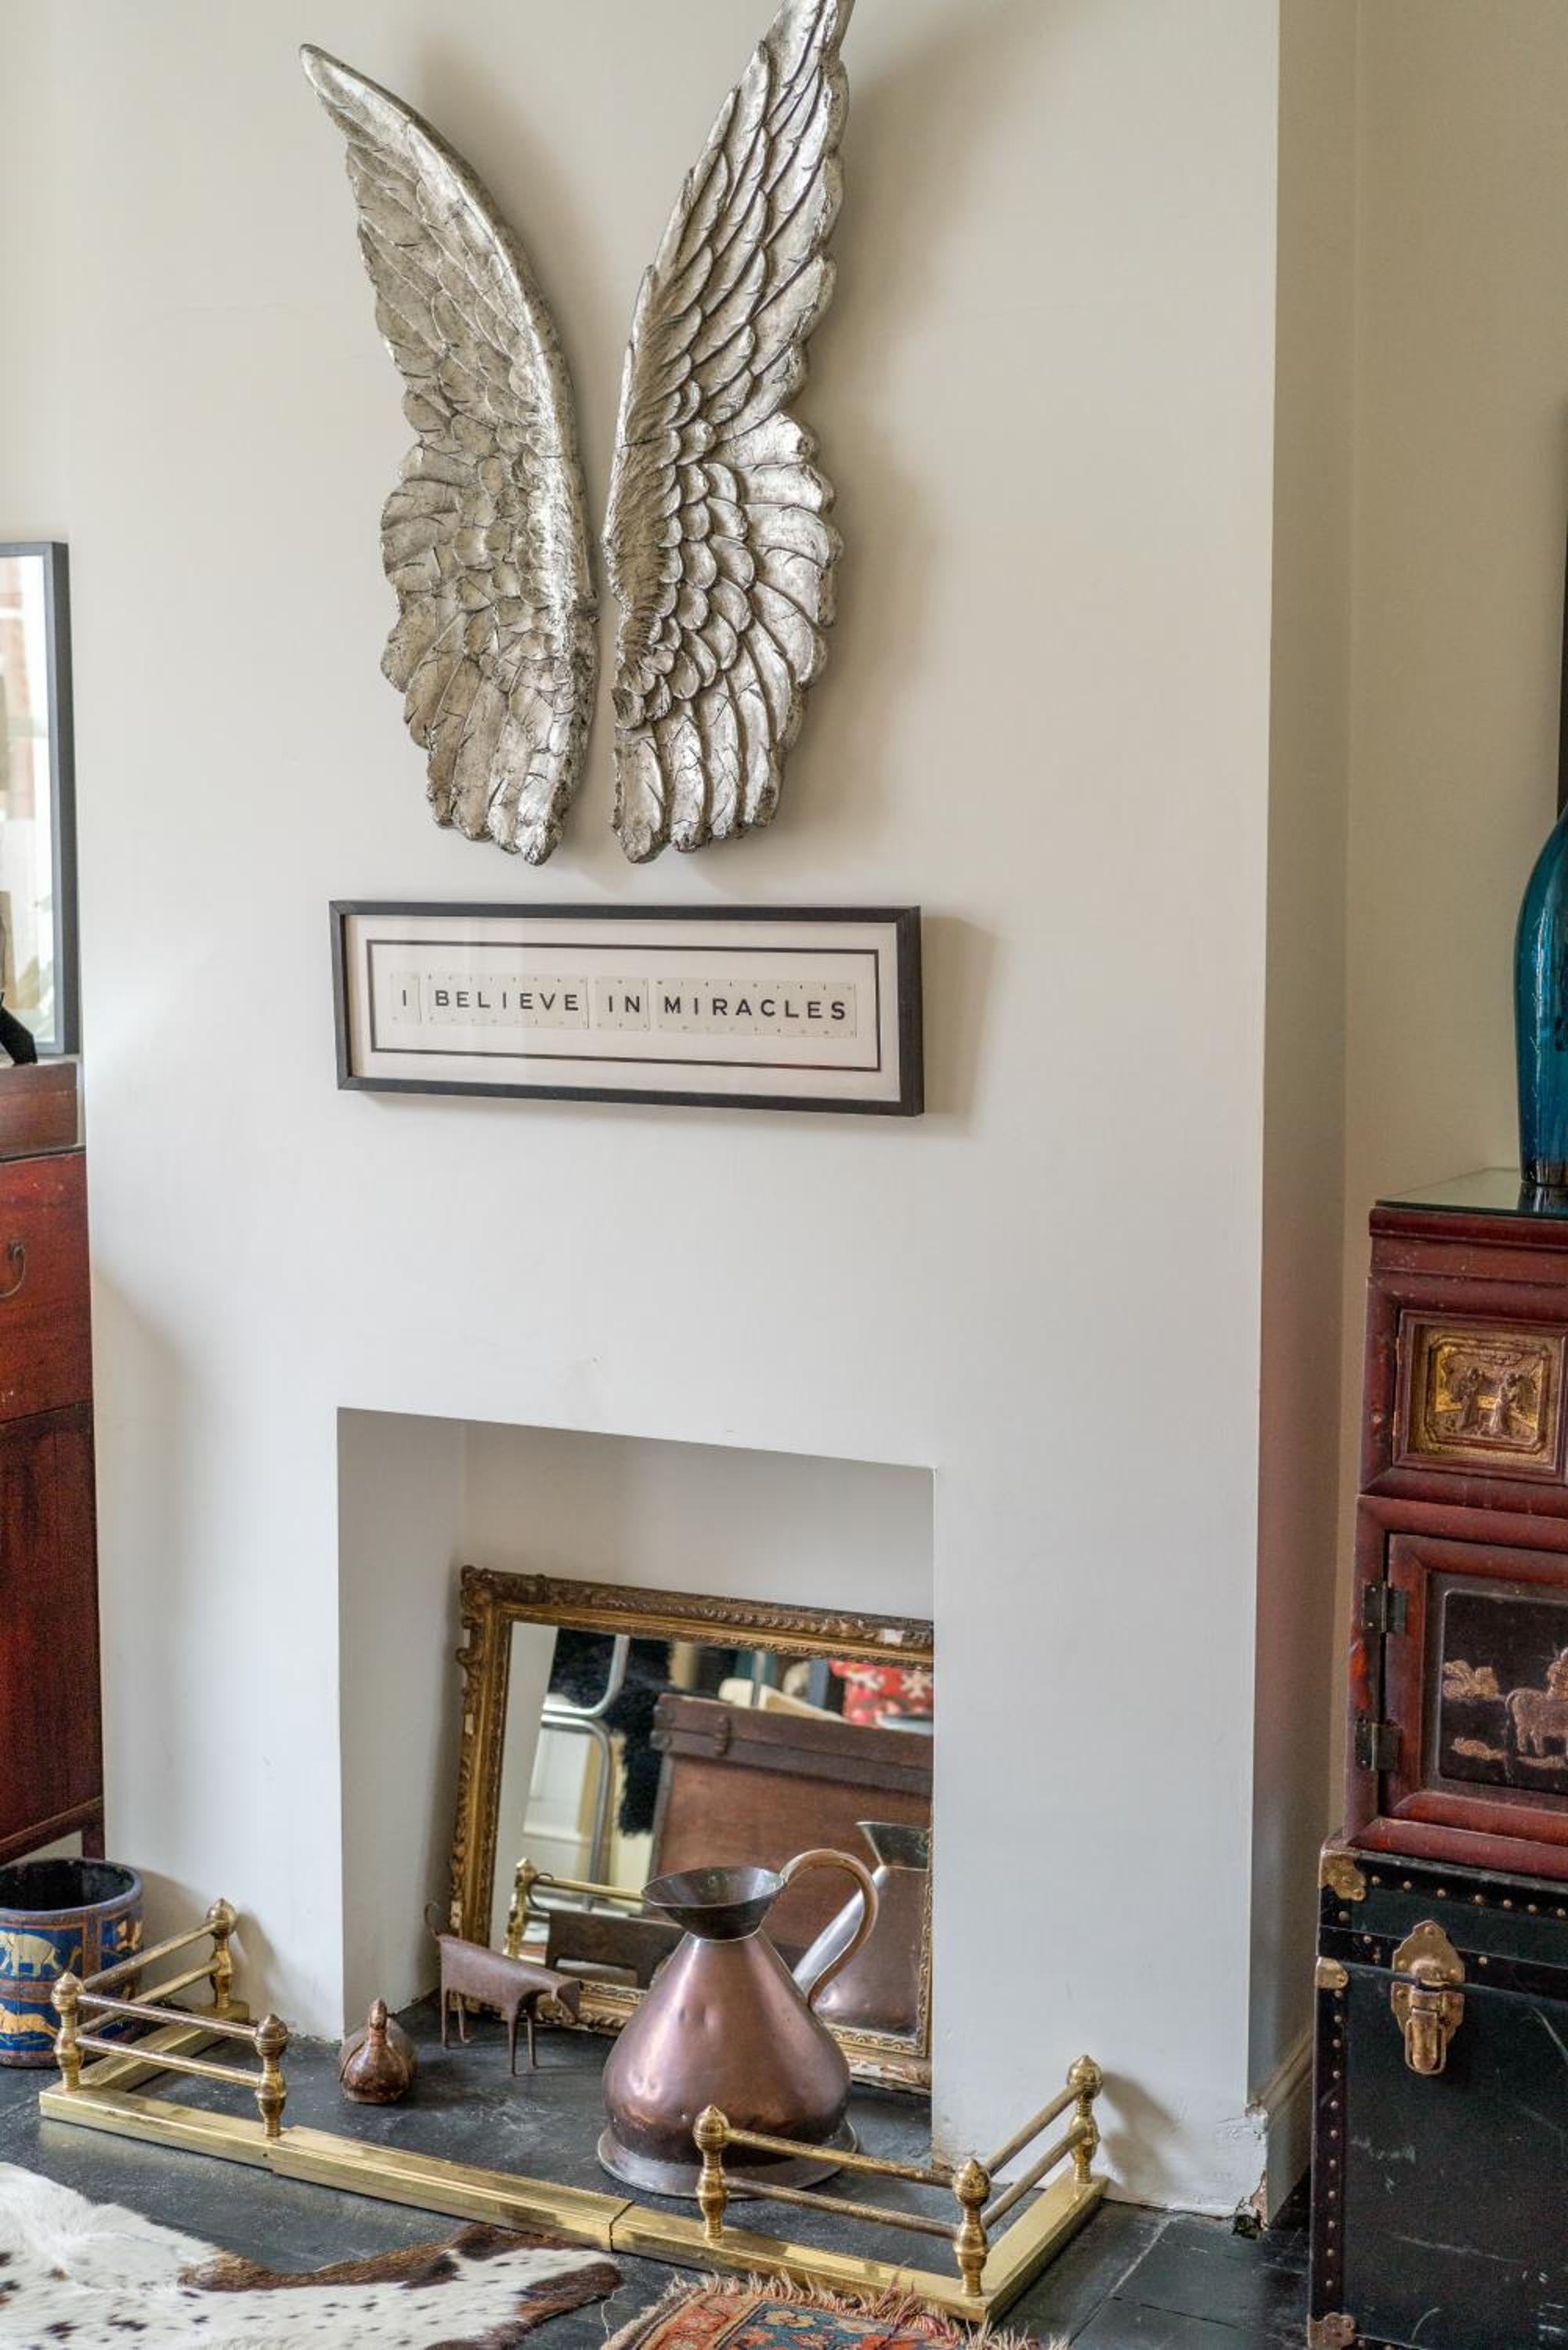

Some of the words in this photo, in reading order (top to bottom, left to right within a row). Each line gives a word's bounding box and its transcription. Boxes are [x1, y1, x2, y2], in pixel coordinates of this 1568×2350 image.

[402, 989, 406, 1007] I
[435, 989, 579, 1013] BELIEVE
[609, 995, 640, 1013] IN
[664, 996, 846, 1021] MIRACLES
